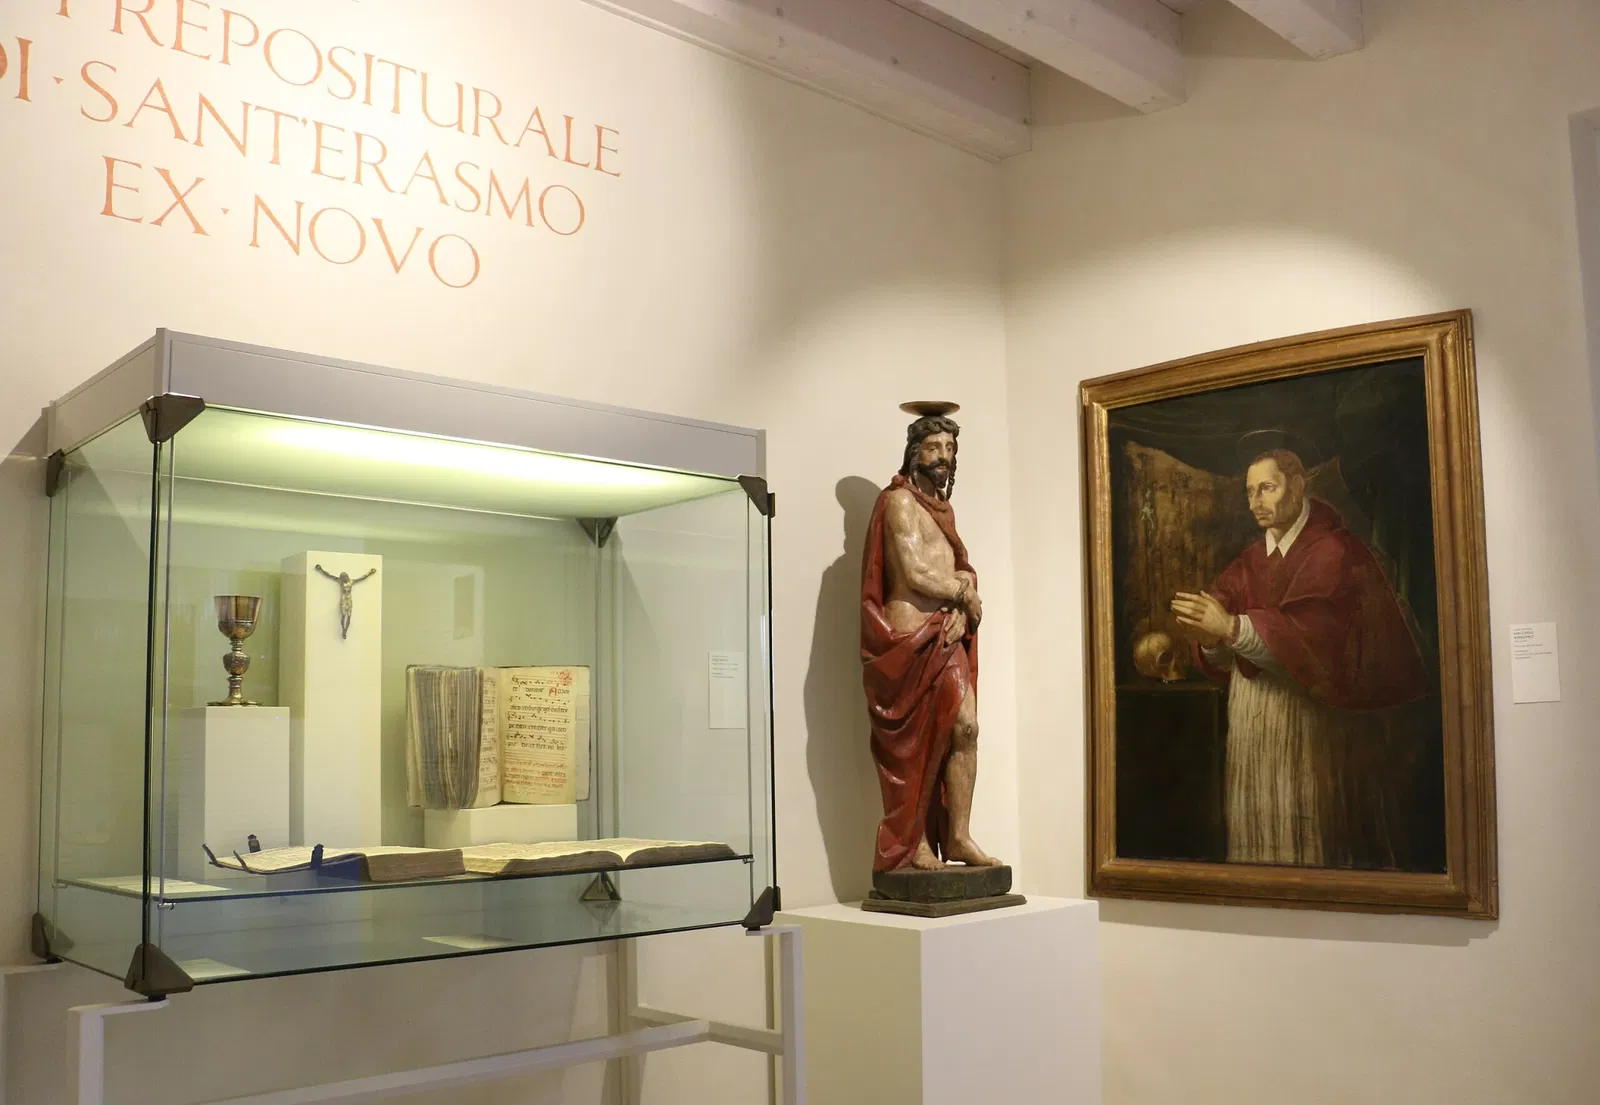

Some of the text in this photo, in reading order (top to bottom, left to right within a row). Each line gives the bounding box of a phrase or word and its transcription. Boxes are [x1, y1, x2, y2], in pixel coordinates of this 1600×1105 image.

[56, 0, 621, 178] REPOSITURALE
[99, 154, 481, 289] EX NOVO
